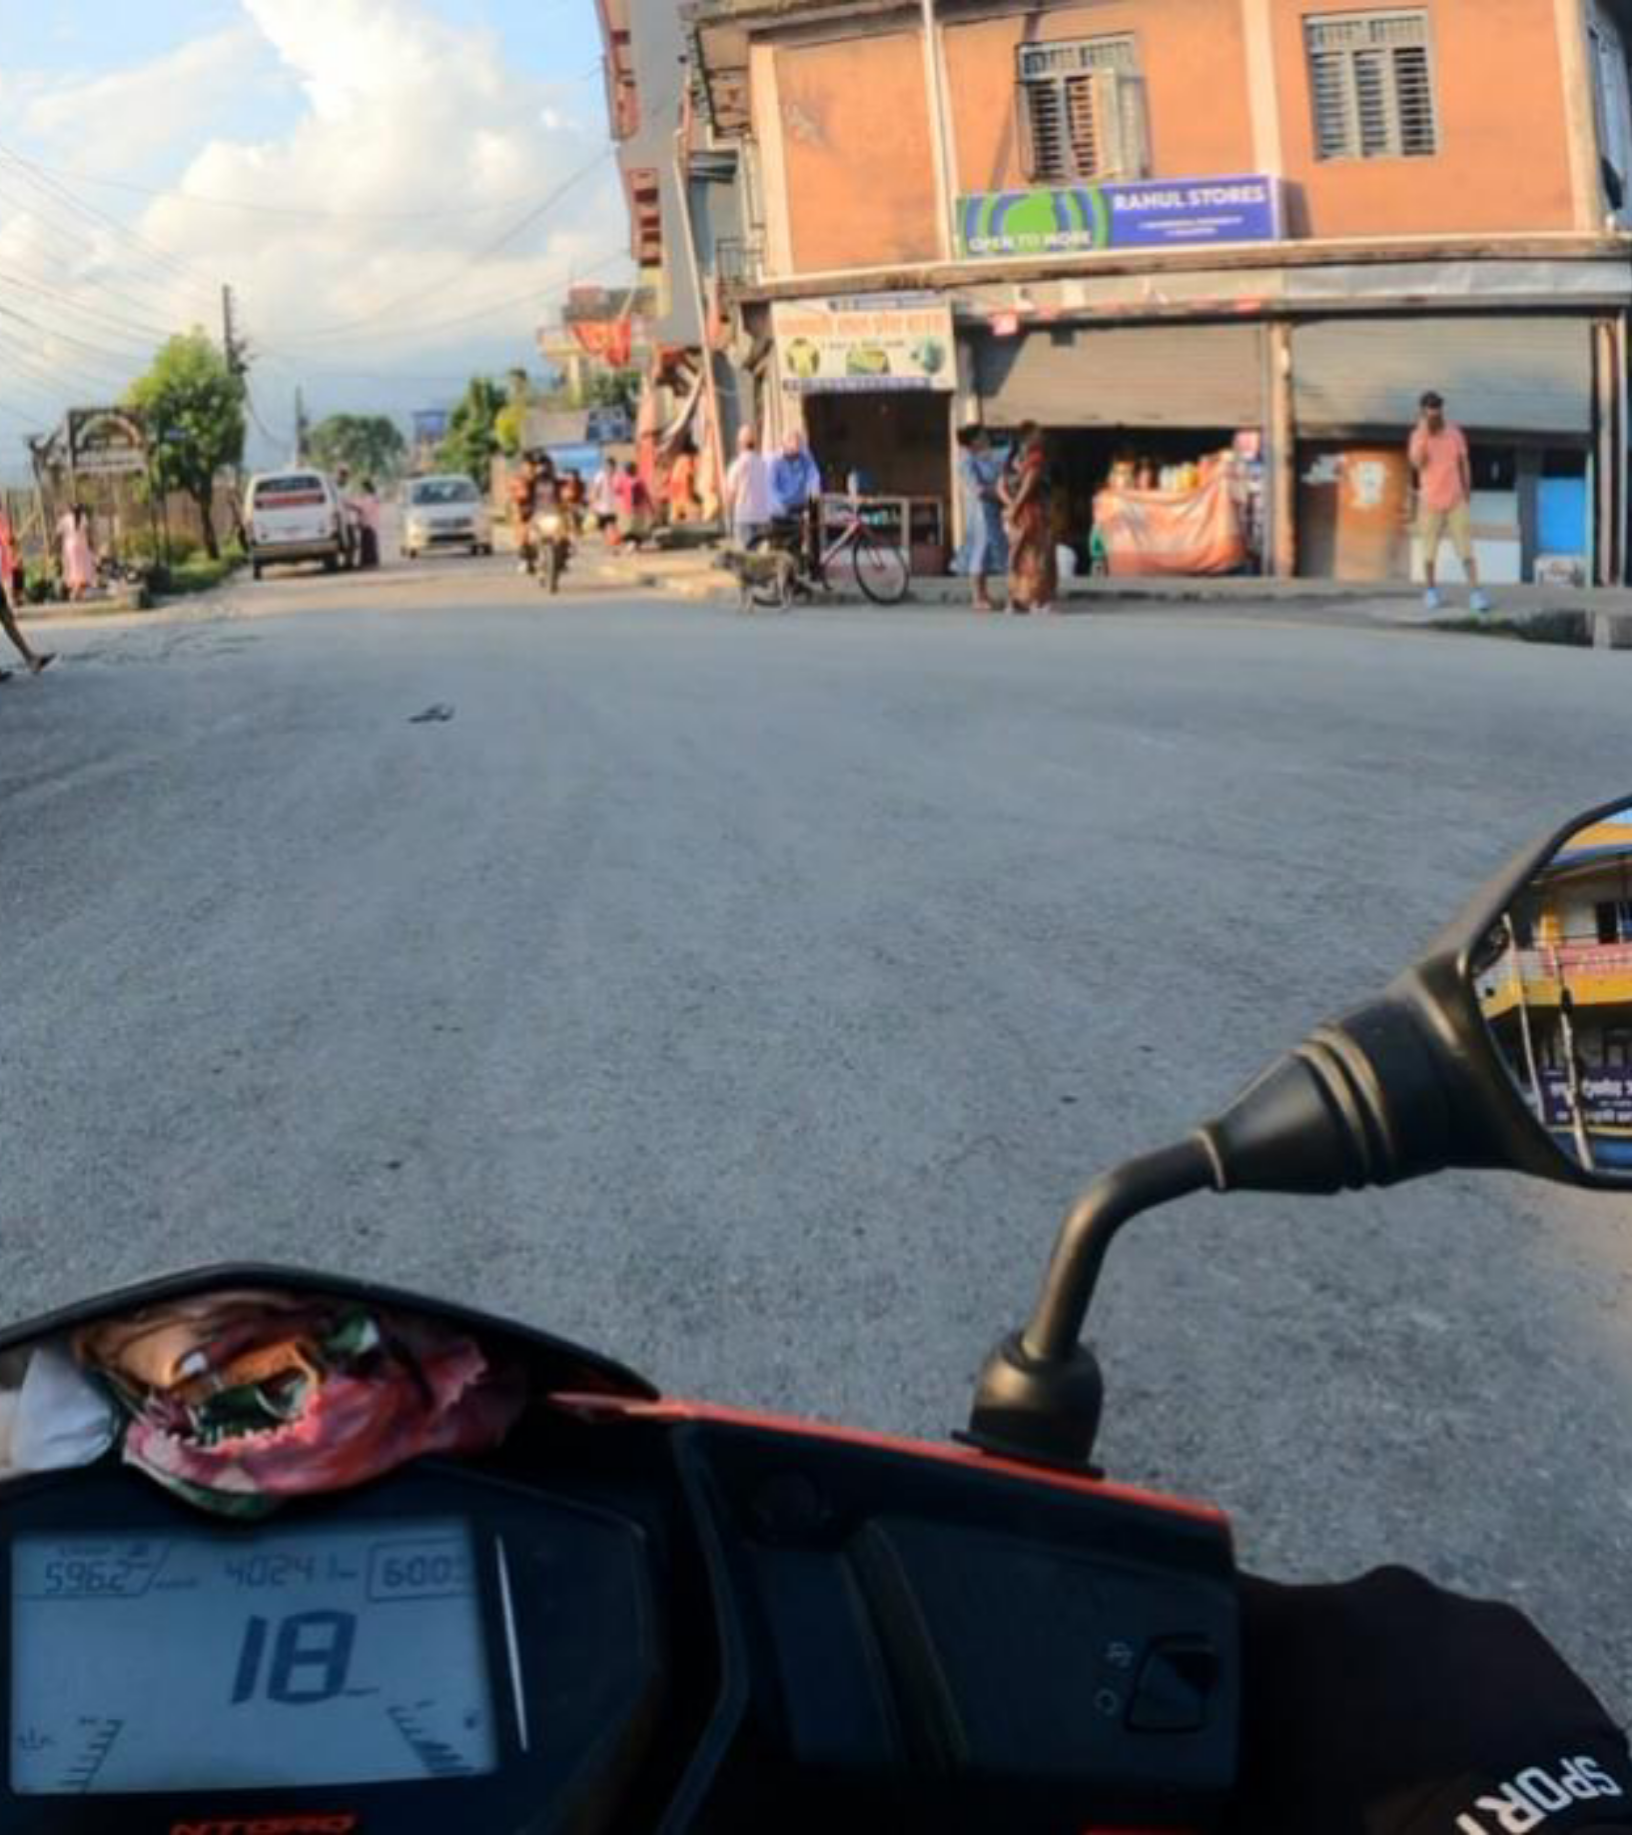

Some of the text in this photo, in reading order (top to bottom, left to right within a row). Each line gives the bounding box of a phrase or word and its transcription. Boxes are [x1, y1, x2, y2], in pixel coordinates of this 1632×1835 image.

[1113, 185, 1266, 211] RAHUL STORES
[968, 236, 1014, 251] OPEN
[230, 1609, 358, 1706] 18
